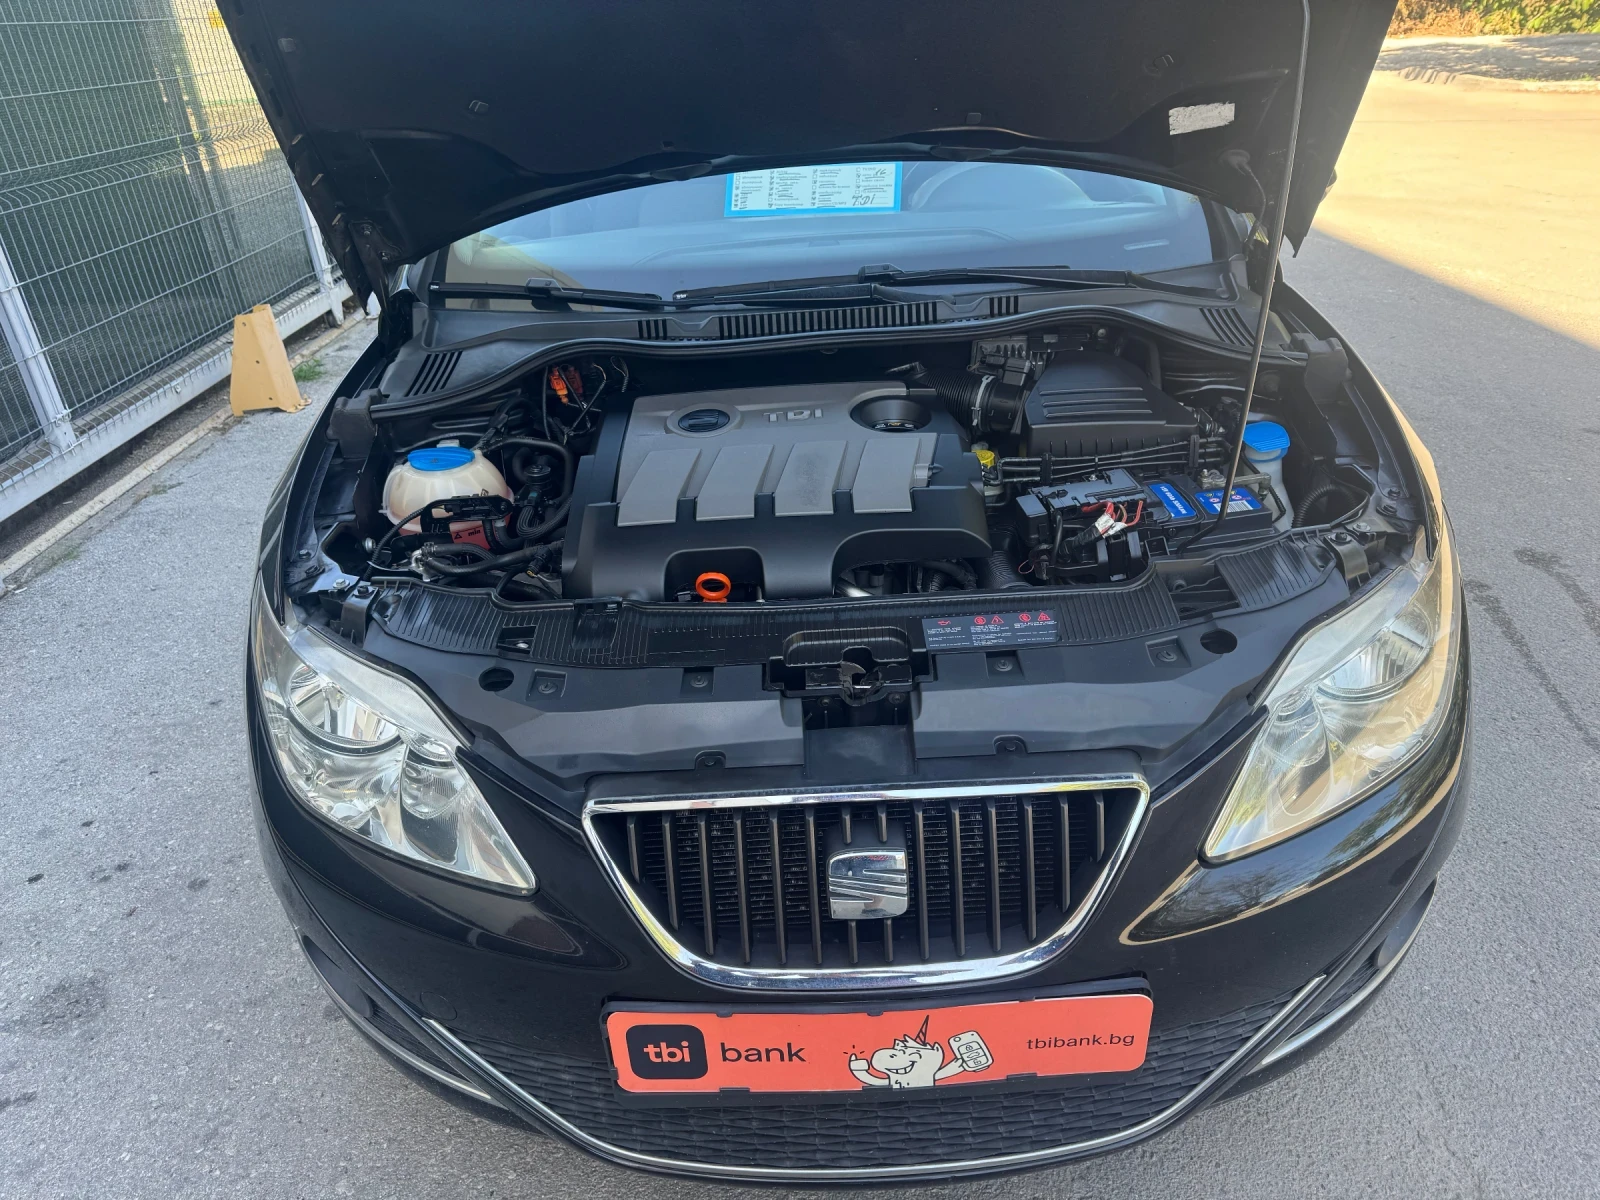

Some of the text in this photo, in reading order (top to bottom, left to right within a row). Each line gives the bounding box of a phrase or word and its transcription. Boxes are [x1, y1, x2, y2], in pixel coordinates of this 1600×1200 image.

[762, 408, 823, 423] TDI
[467, 529, 481, 537] min
[1026, 1033, 1135, 1050] tbibank.bg
[643, 1040, 806, 1063] tbi bank
